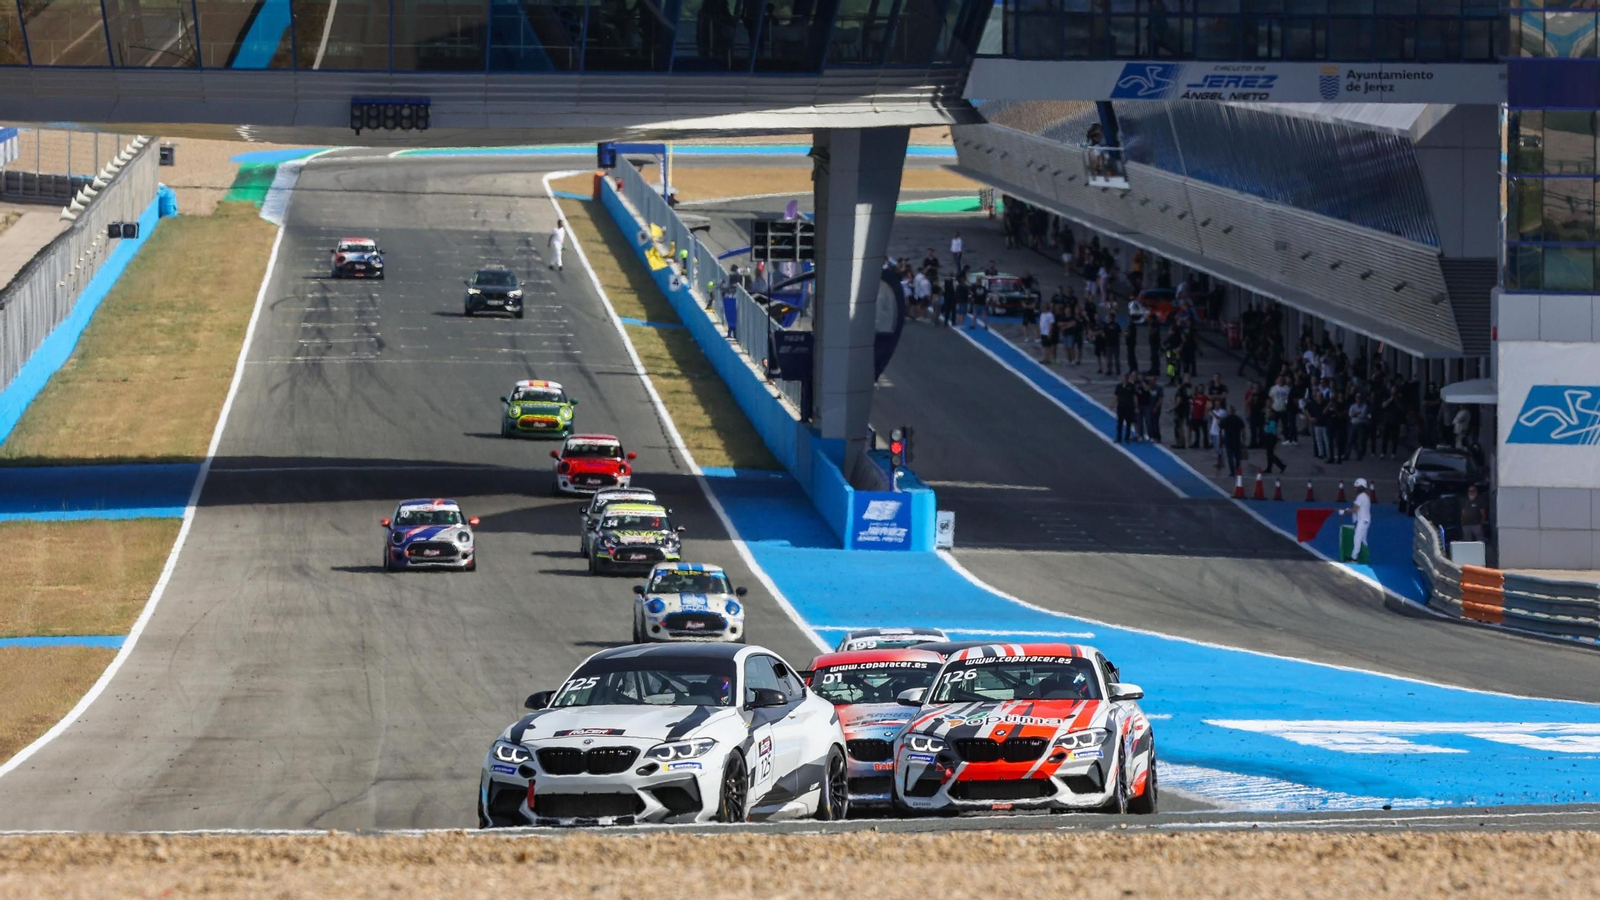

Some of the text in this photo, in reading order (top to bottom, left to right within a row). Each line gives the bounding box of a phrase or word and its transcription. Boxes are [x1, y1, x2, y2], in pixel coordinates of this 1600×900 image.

[1346, 69, 1434, 81] Ayuntamiento
[1186, 75, 1278, 88] JEREZ
[1346, 82, 1395, 94] de Jerez
[1229, 92, 1270, 100] NIETO
[965, 655, 1073, 666] www.coparacer.es
[829, 661, 928, 673] www.coparacer.es
[942, 668, 978, 684] 126
[564, 676, 601, 692] 125
